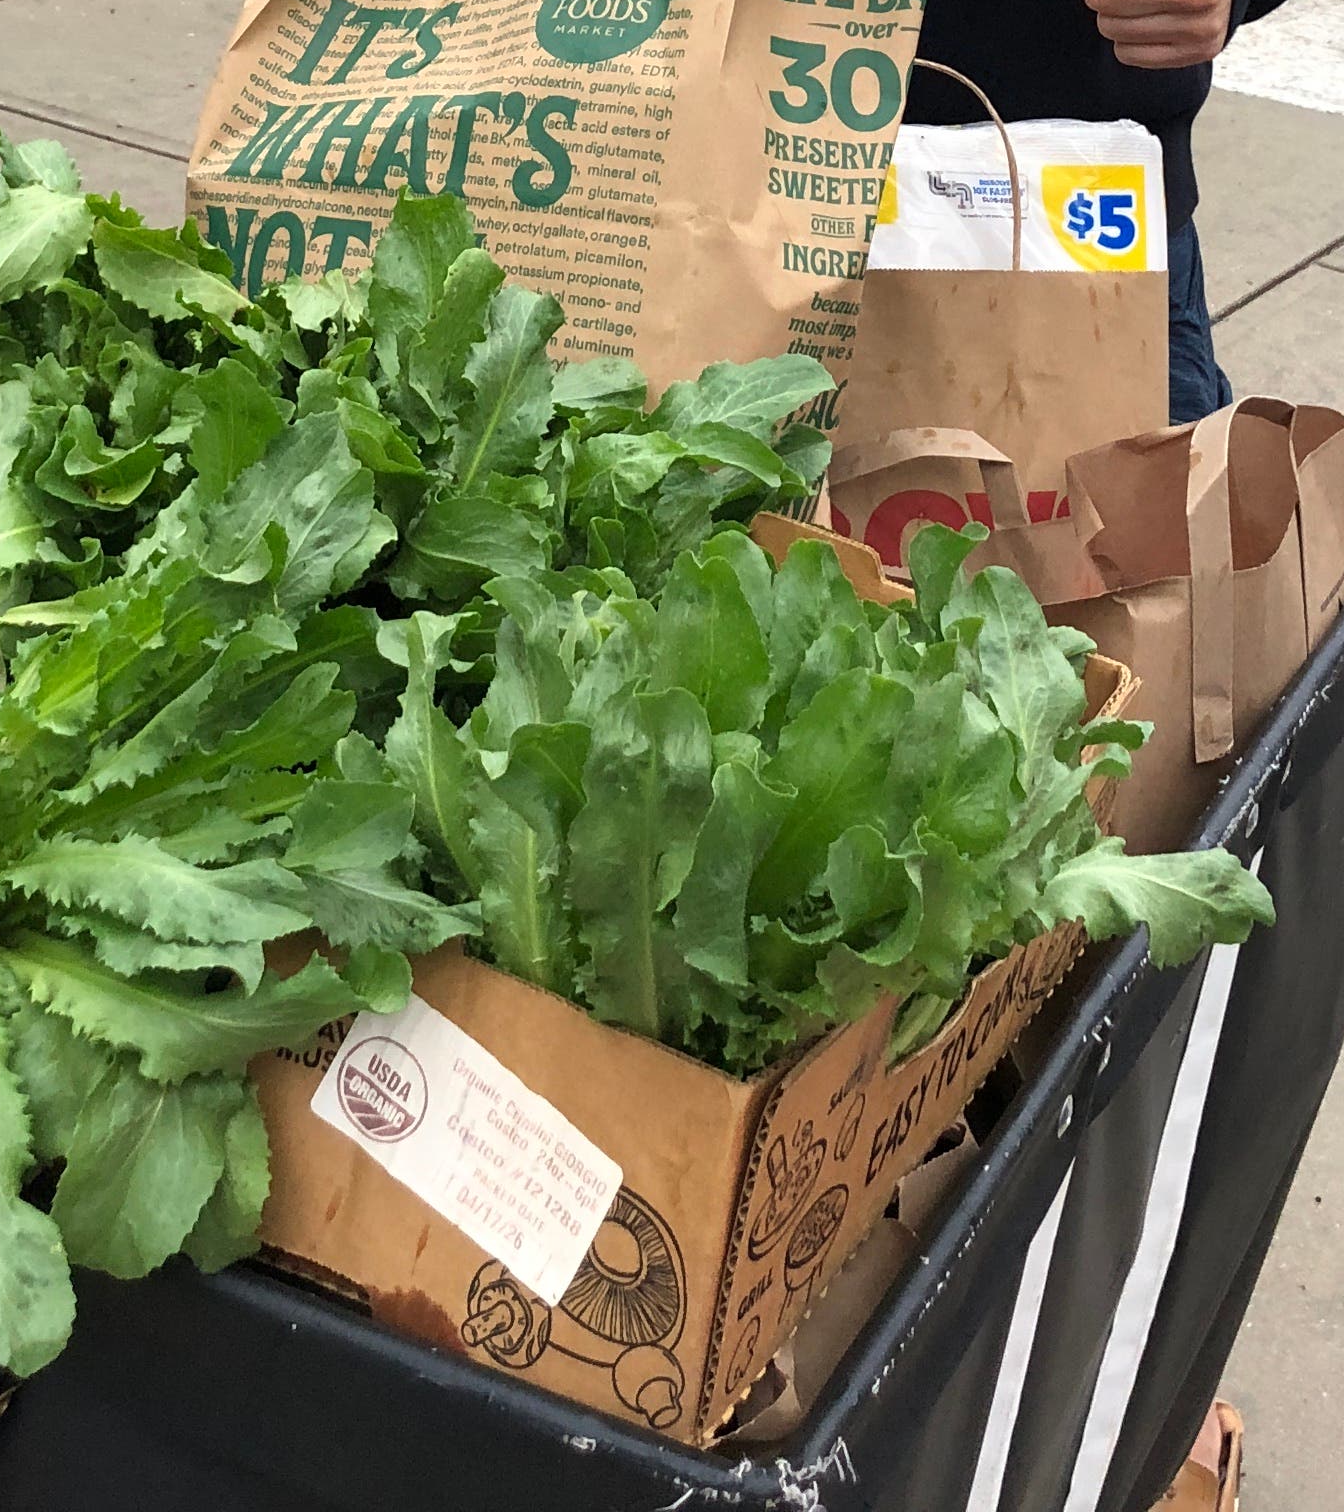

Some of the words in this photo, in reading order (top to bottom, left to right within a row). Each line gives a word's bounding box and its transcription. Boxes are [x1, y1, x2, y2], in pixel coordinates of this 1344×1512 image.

[553, 24, 627, 38] MARKET
[844, 20, 899, 39] over
[642, 47, 686, 60] sodium
[640, 63, 680, 80] EDTA,
[588, 81, 642, 97] guanylic
[644, 87, 677, 101] acid,
[768, 34, 914, 133] 30
[644, 104, 673, 122] high
[581, 121, 608, 135] acid
[611, 126, 651, 139] esters
[655, 128, 672, 141] of
[223, 91, 579, 208] WHAT'S
[585, 141, 665, 165] diglutamate,
[763, 127, 895, 171] PRESERVA
[587, 163, 636, 181] mineral
[642, 170, 662, 186] oil,
[767, 166, 885, 206] SWEETE
[587, 187, 658, 208] glutamate,
[551, 203, 605, 221] identical
[606, 207, 655, 230] flavors,
[810, 216, 856, 235] OTHER
[1066, 192, 1137, 251] $5
[476, 216, 511, 234] whey,
[512, 221, 543, 237] octyl
[543, 223, 589, 242] gallate,
[590, 232, 637, 249] orange
[494, 240, 570, 263] petrolatum,
[574, 250, 648, 274] picamilon,
[782, 242, 869, 282] INGRE
[566, 273, 645, 296] propionate,
[567, 292, 612, 309] mono-
[614, 300, 642, 314] and
[810, 290, 860, 317] becaus
[572, 315, 638, 338] cartilage,
[787, 316, 829, 336] most
[563, 336, 635, 358] aluminum
[826, 345, 847, 360] we
[367, 1053, 412, 1103] USDA
[349, 1074, 407, 1130] ORGANIC
[864, 1059, 938, 1189] EASY
[935, 1027, 968, 1102] TO
[452, 1056, 503, 1106] Organic
[554, 1141, 609, 1198] GIORGIO
[486, 1108, 530, 1152] Costco
